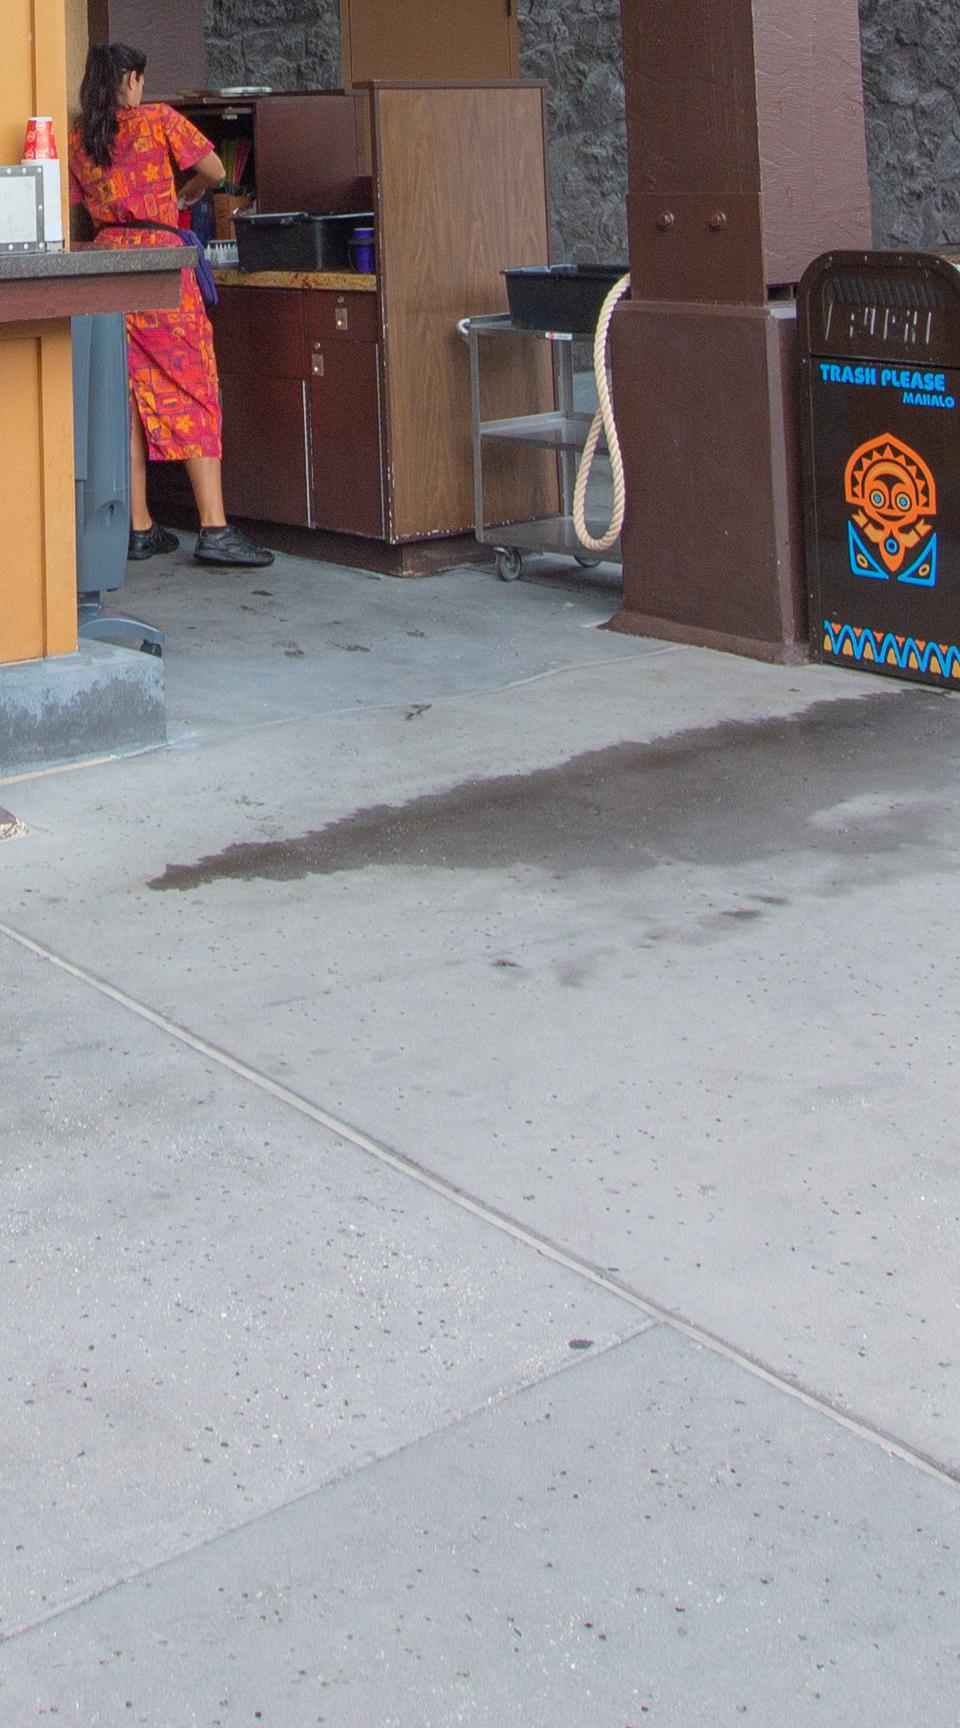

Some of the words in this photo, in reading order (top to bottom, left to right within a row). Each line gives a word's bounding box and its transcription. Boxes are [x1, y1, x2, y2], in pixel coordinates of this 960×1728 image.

[820, 363, 877, 386] TRASH
[881, 369, 945, 392] PLEASE
[903, 392, 955, 409] MAHALO
